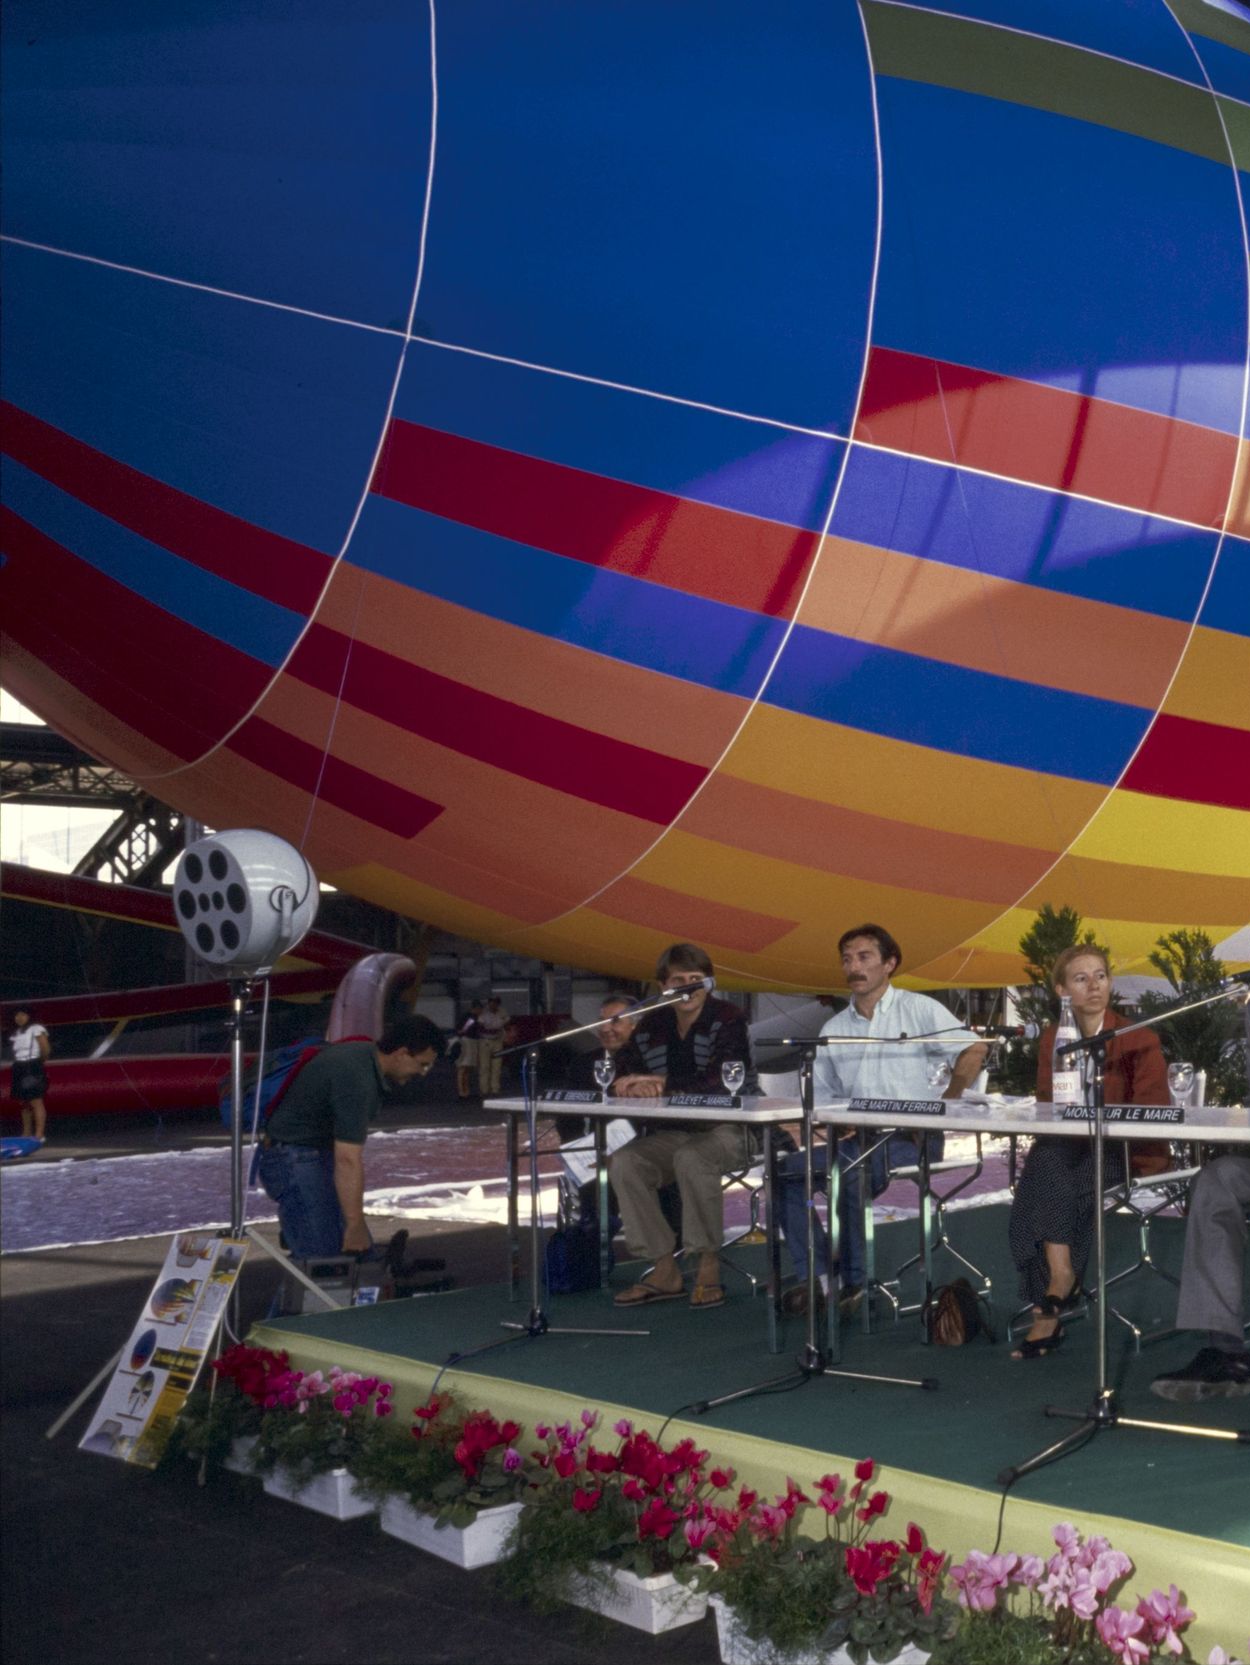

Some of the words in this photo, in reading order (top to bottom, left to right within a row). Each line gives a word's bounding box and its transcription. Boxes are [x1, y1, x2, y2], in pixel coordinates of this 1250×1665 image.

[868, 1101, 902, 1111] MARTIN
[902, 1102, 942, 1113] FERRARI
[1065, 1107, 1122, 1119] MONSUR
[1126, 1108, 1142, 1120] LE
[1144, 1109, 1180, 1121] MAIRE
